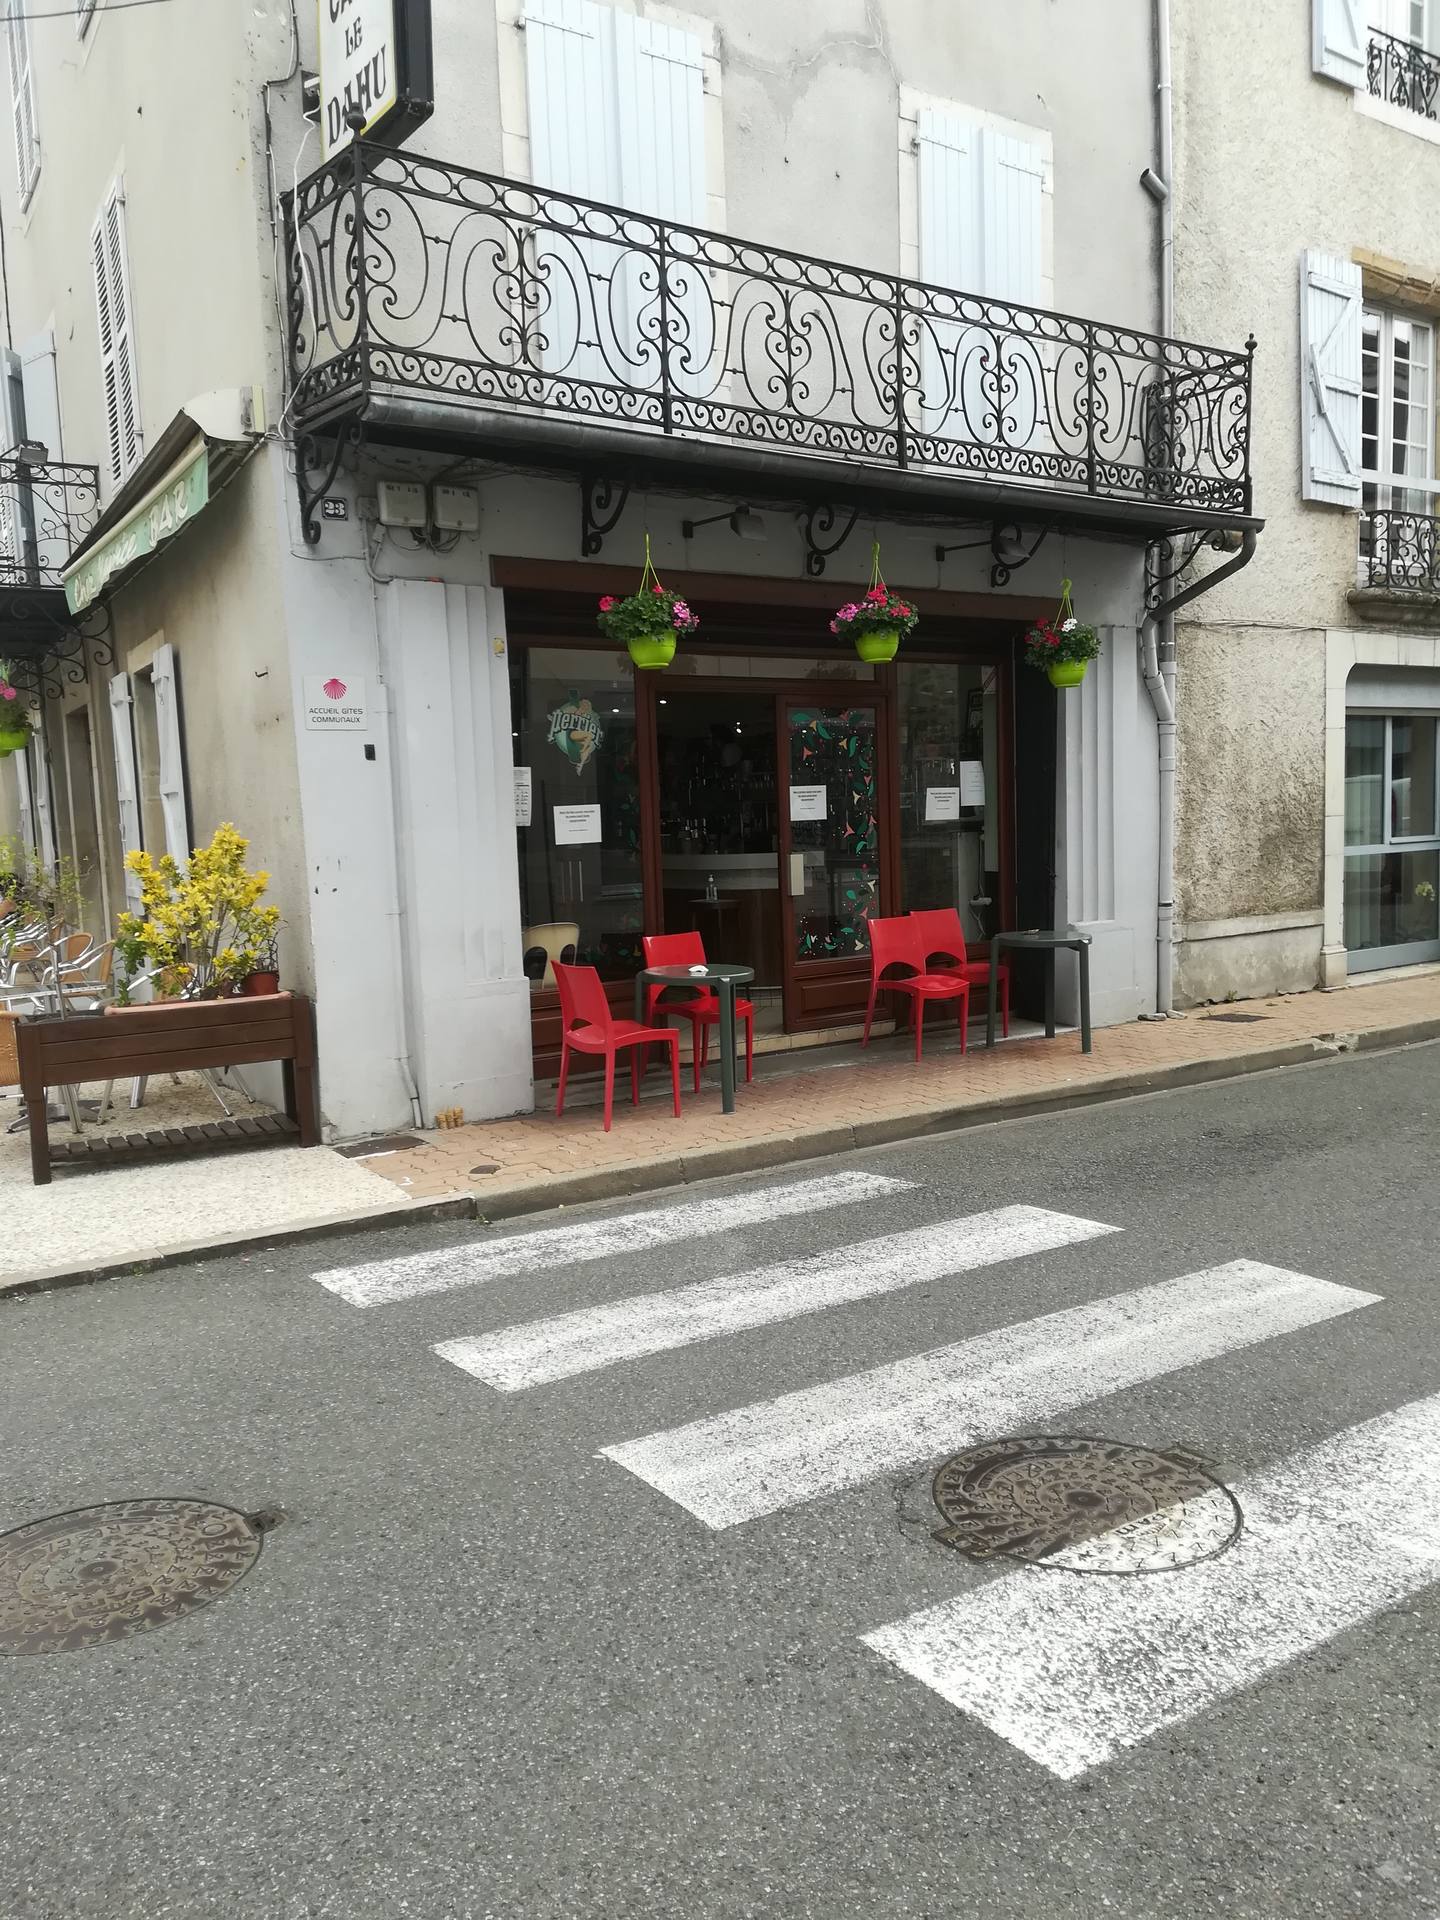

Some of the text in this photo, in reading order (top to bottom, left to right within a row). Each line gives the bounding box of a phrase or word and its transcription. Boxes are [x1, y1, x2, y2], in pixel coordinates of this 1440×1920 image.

[344, 16, 362, 59] LE
[327, 43, 386, 148] DAHU
[149, 480, 189, 548] BAR
[324, 501, 346, 516] 23
[309, 707, 340, 715] ACCUEIL
